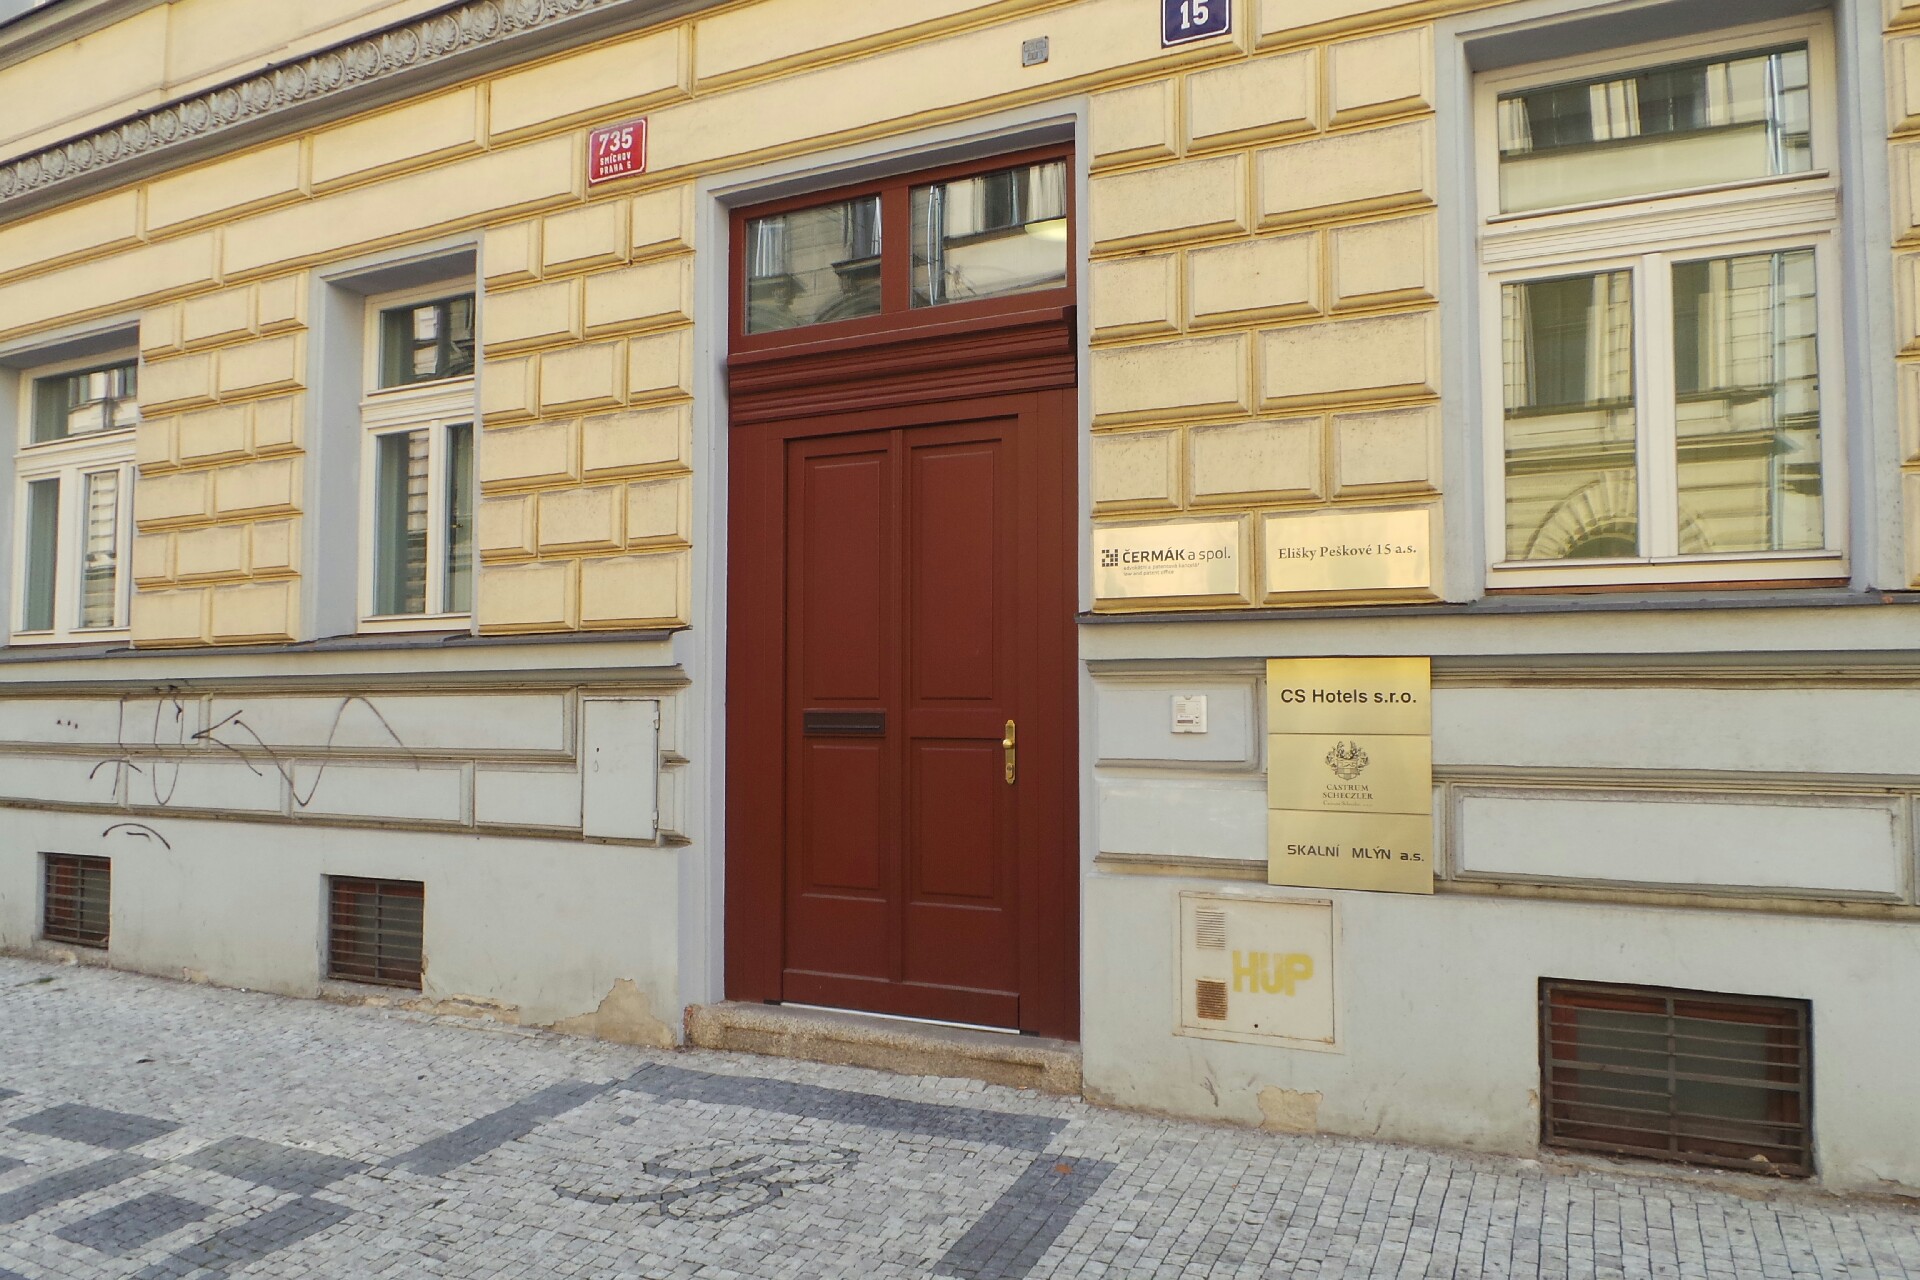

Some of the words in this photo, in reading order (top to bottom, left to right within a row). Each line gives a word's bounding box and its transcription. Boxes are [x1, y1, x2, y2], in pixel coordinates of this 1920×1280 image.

[1180, 0, 1209, 29] 15
[599, 127, 633, 155] 735
[600, 152, 631, 166] SMÍCHOV
[600, 163, 623, 175] PRAHA
[1122, 547, 1185, 563] ČERMÁK
[1187, 551, 1196, 560] a
[1198, 546, 1231, 562] spol.
[1278, 546, 1317, 560] Elišky
[1320, 544, 1372, 558] Peškové
[1377, 543, 1391, 555] 15
[1395, 545, 1417, 554] a.s.
[1280, 689, 1306, 703] CS
[1312, 689, 1368, 703] Hotels
[1374, 691, 1417, 703] s.r.o.
[1322, 792, 1374, 800] SCHECZLER
[1287, 844, 1340, 857] SKALNÍ
[1352, 846, 1391, 860] MLÝN
[1400, 852, 1425, 861] a.s.
[1232, 950, 1315, 997] HUP
